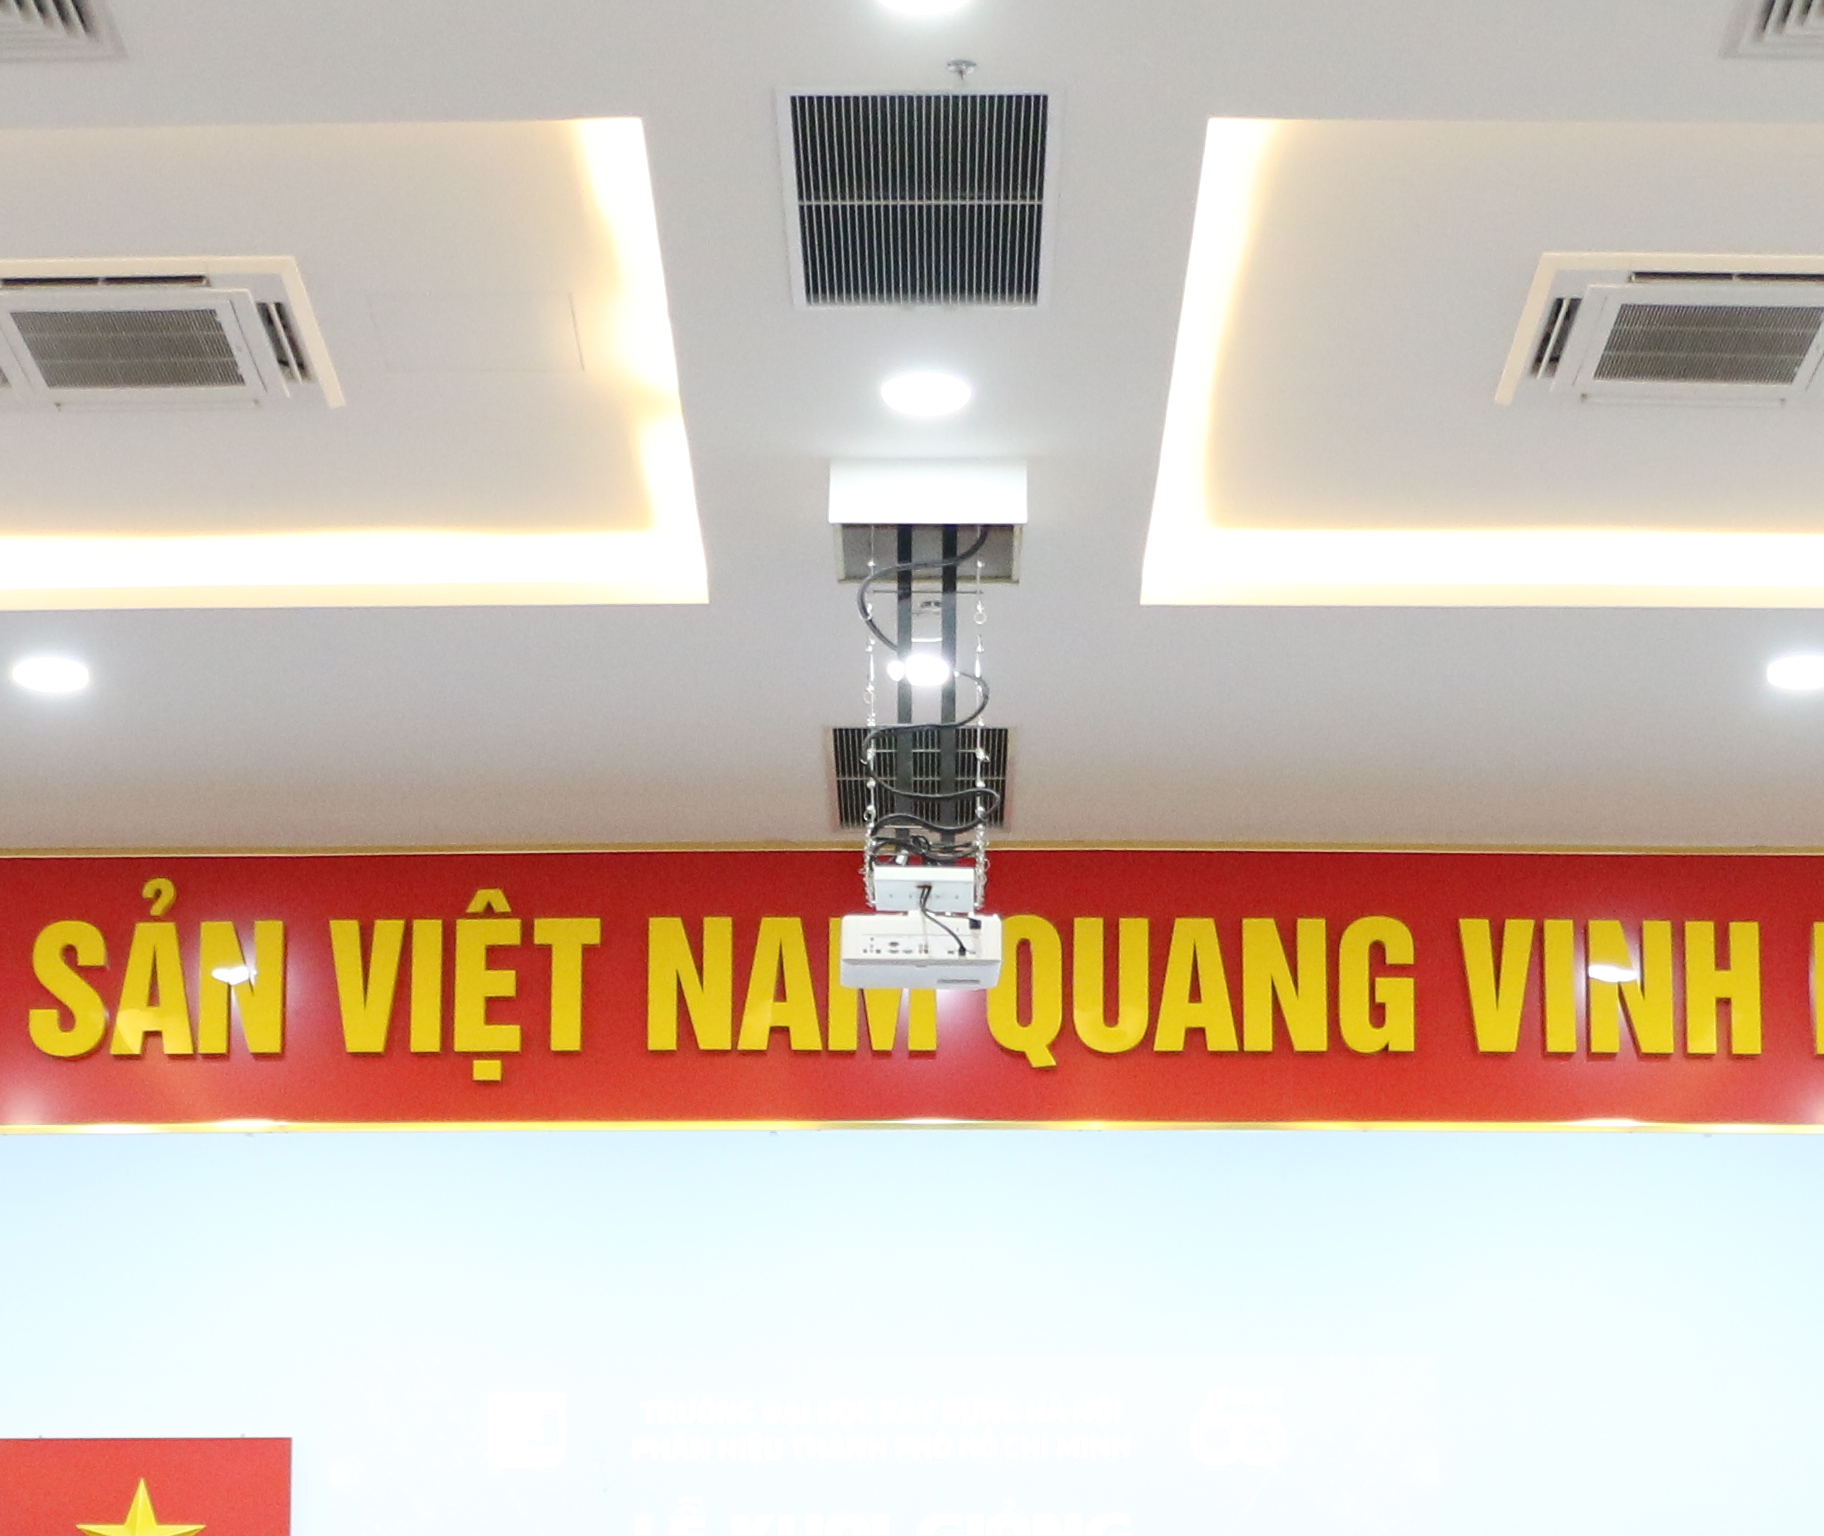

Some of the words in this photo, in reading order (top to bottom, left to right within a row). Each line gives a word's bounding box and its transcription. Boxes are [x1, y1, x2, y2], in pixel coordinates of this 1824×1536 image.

[29, 878, 287, 1060] SẢN
[330, 889, 600, 1080] VIỆT
[986, 914, 1415, 1068] QUANG
[1459, 919, 1762, 1057] VINH
